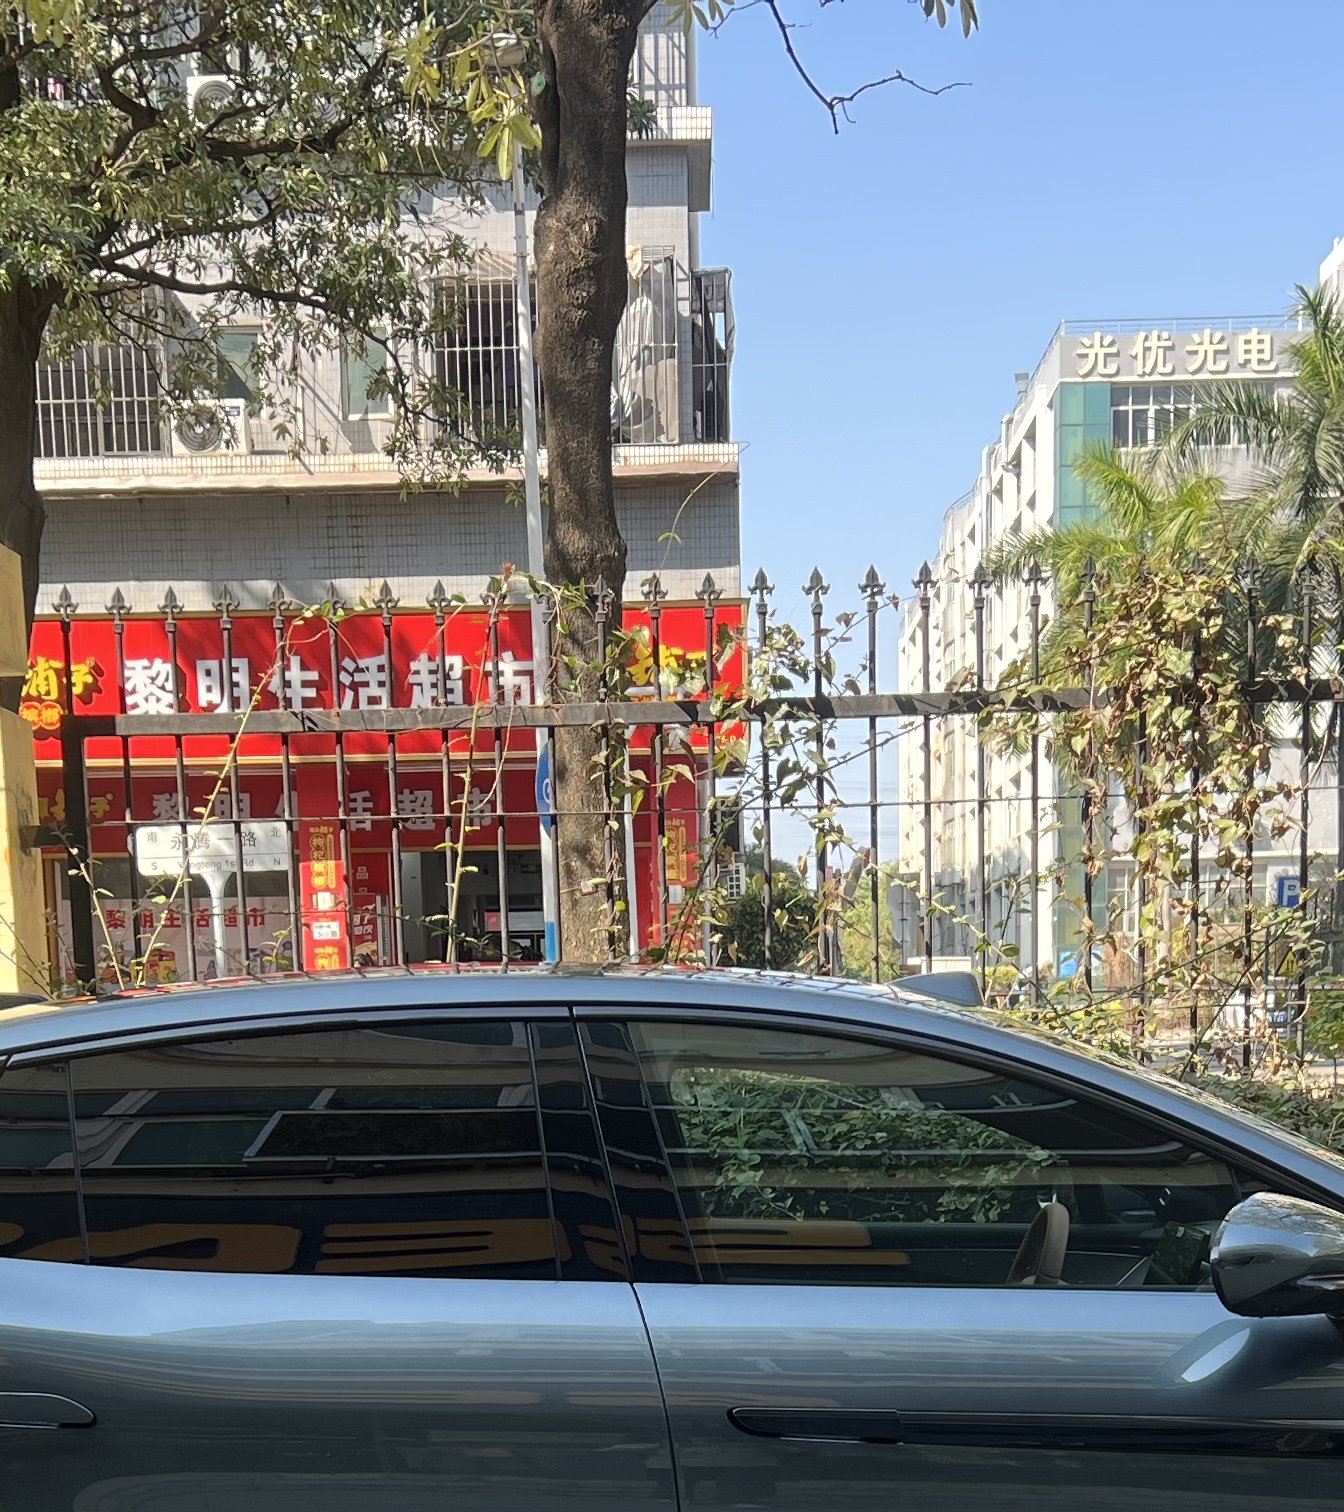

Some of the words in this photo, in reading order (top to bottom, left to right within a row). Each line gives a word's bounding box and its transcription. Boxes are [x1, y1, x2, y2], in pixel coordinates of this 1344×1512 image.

[1075, 327, 1278, 377] 光优光电
[123, 651, 534, 714] 黎明生活超市
[270, 827, 282, 838] 北
[151, 862, 158, 871] S
[177, 859, 222, 870] Yngteng
[274, 857, 282, 866] N
